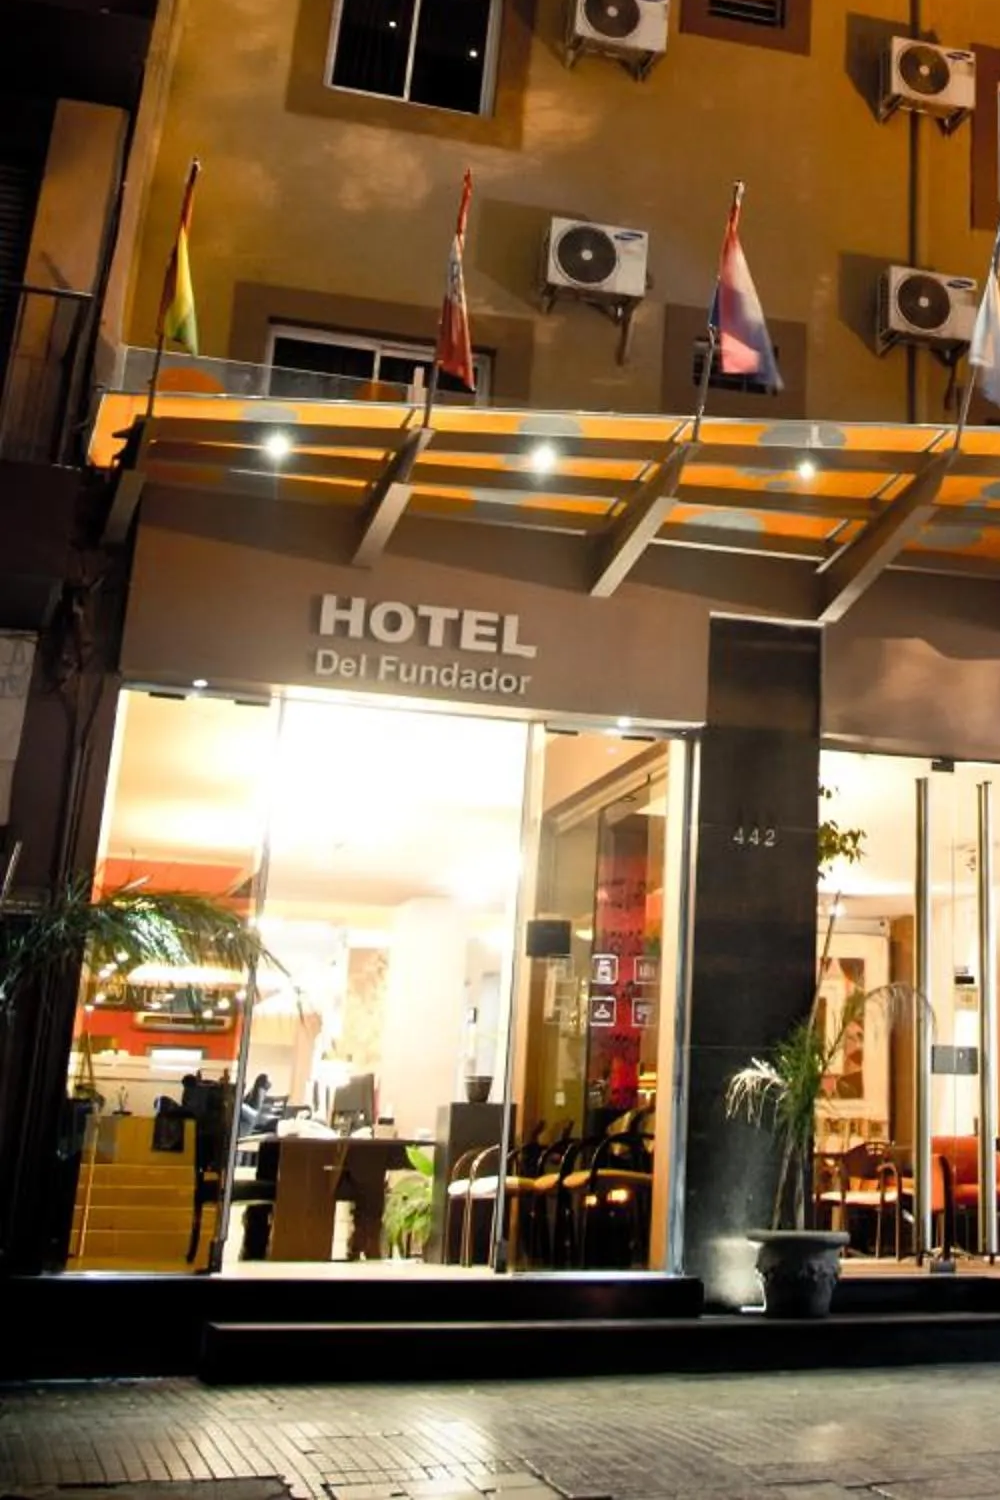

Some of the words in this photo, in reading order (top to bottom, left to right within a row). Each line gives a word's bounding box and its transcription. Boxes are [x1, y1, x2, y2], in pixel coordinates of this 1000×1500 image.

[319, 593, 538, 659] HOTEL
[315, 649, 367, 677] Del
[378, 654, 532, 695] Fundador
[732, 826, 776, 847] 442
